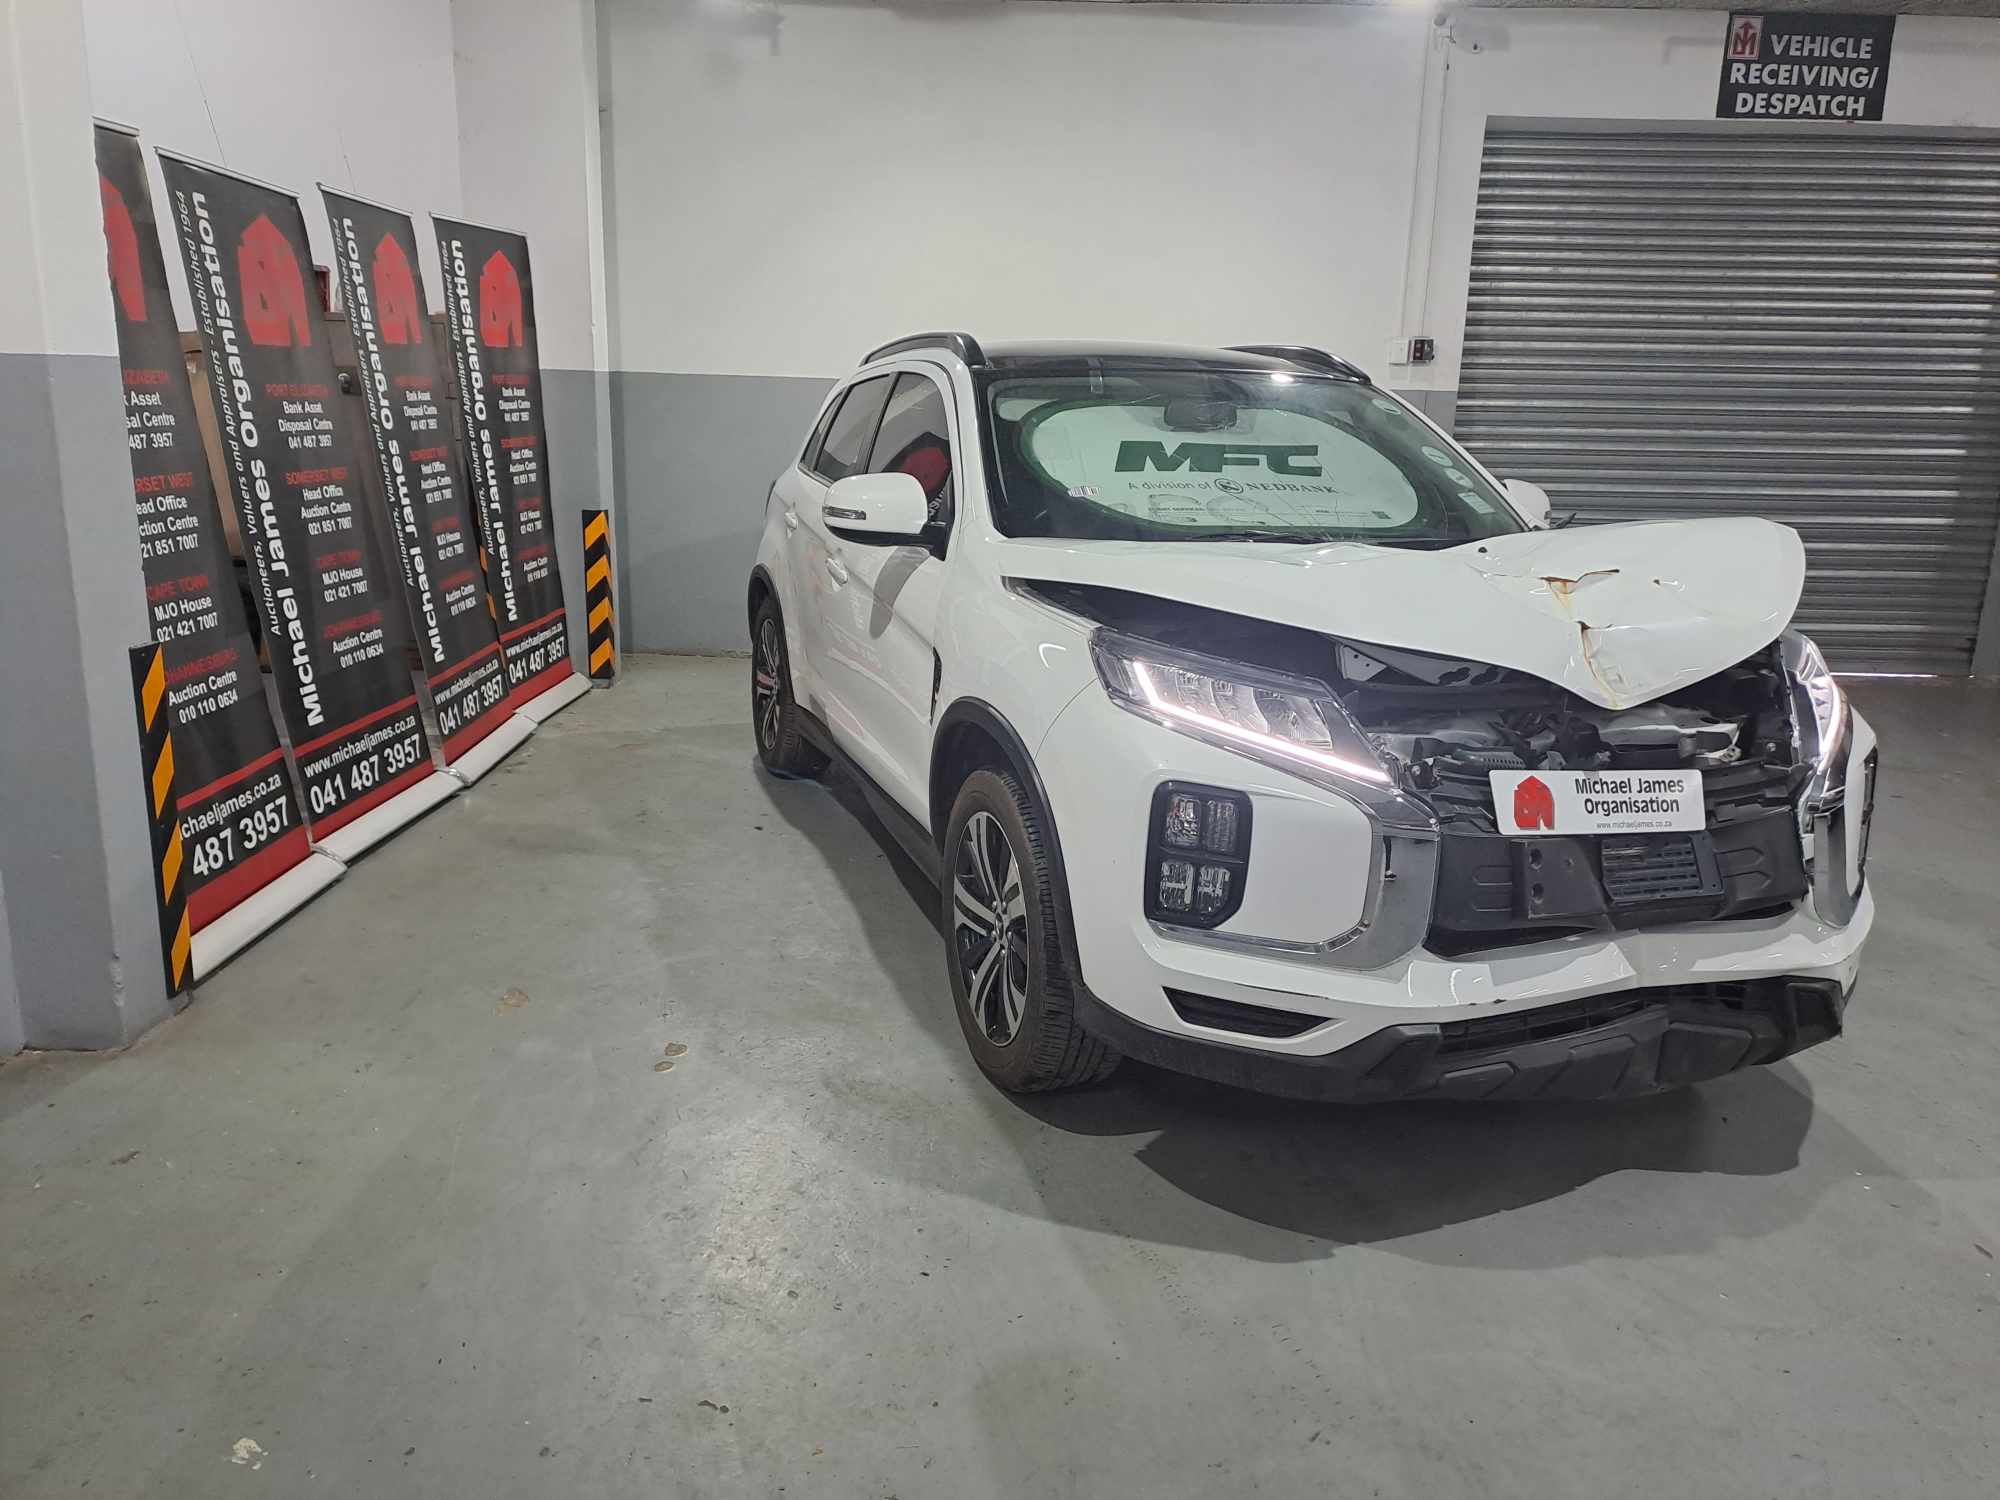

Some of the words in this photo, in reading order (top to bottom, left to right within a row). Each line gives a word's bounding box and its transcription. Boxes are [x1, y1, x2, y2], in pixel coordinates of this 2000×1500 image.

[1771, 34, 1873, 59] VEHICLE
[1729, 62, 1879, 89] RECEIVING/
[1735, 92, 1866, 117] DESPATCH
[175, 189, 193, 234] 1964
[184, 236, 215, 336] Established
[192, 191, 258, 448] Organisation
[343, 217, 394, 430] Organisation
[451, 240, 487, 422] Organisation
[211, 350, 237, 437] Appraisers
[456, 351, 472, 413] Appraisers
[131, 390, 162, 406] Asset
[282, 401, 302, 414] Bank
[143, 411, 175, 427] Centre
[278, 419, 312, 434] Disposal
[464, 413, 476, 439] and
[129, 433, 147, 449] 487
[150, 432, 173, 448] 3957
[288, 436, 302, 449] 041
[303, 435, 317, 448] 487
[372, 423, 384, 450] and
[228, 439, 244, 472] and
[470, 441, 482, 483] Valuers
[1114, 440, 1323, 477] MFC
[380, 454, 396, 502] Valuers
[480, 429, 502, 514] James
[302, 487, 322, 501] Head
[388, 439, 418, 539] James
[1128, 482, 1138, 490] A
[1142, 481, 1193, 490] division
[1199, 481, 1212, 490] of
[1243, 482, 1338, 494] NEDBANK
[156, 495, 188, 512] Office
[238, 476, 257, 535] Valuers
[250, 458, 289, 577] James
[301, 504, 329, 520] Auction
[167, 514, 199, 532] Centre
[308, 522, 321, 536] 021
[322, 519, 336, 533] 851
[154, 538, 175, 556] 851
[176, 533, 199, 551] 7007
[338, 567, 363, 581] House
[493, 521, 518, 622] Michael
[254, 541, 282, 635] Auctioneers,
[324, 588, 337, 602] 021
[338, 584, 351, 598] 421
[154, 601, 179, 622] MJO
[180, 596, 212, 614] House
[409, 546, 445, 663] Michael
[157, 625, 175, 642] 021
[177, 618, 196, 636] 421
[197, 612, 219, 631] 7007
[276, 587, 325, 727] Michael
[332, 636, 360, 654] Auction
[353, 648, 366, 663] 110
[509, 658, 528, 684] 041
[529, 648, 545, 672] 487
[547, 636, 565, 663] 3957
[168, 681, 208, 707] Auction
[208, 670, 238, 690] Centre
[179, 705, 196, 724] 010
[197, 698, 216, 716] 110
[218, 688, 239, 708] 0634
[440, 704, 461, 735] 041
[462, 690, 480, 719] 487
[481, 674, 503, 706] 3957
[304, 715, 416, 778] www.michaeljames.co.za
[310, 773, 346, 814] 041
[350, 754, 380, 791] 487
[383, 733, 421, 773] 3957
[1575, 778, 1632, 795] Michael
[1637, 779, 1684, 794] James
[1584, 797, 1680, 817] Organisation
[193, 827, 234, 876] 487
[240, 795, 288, 849] 3957
